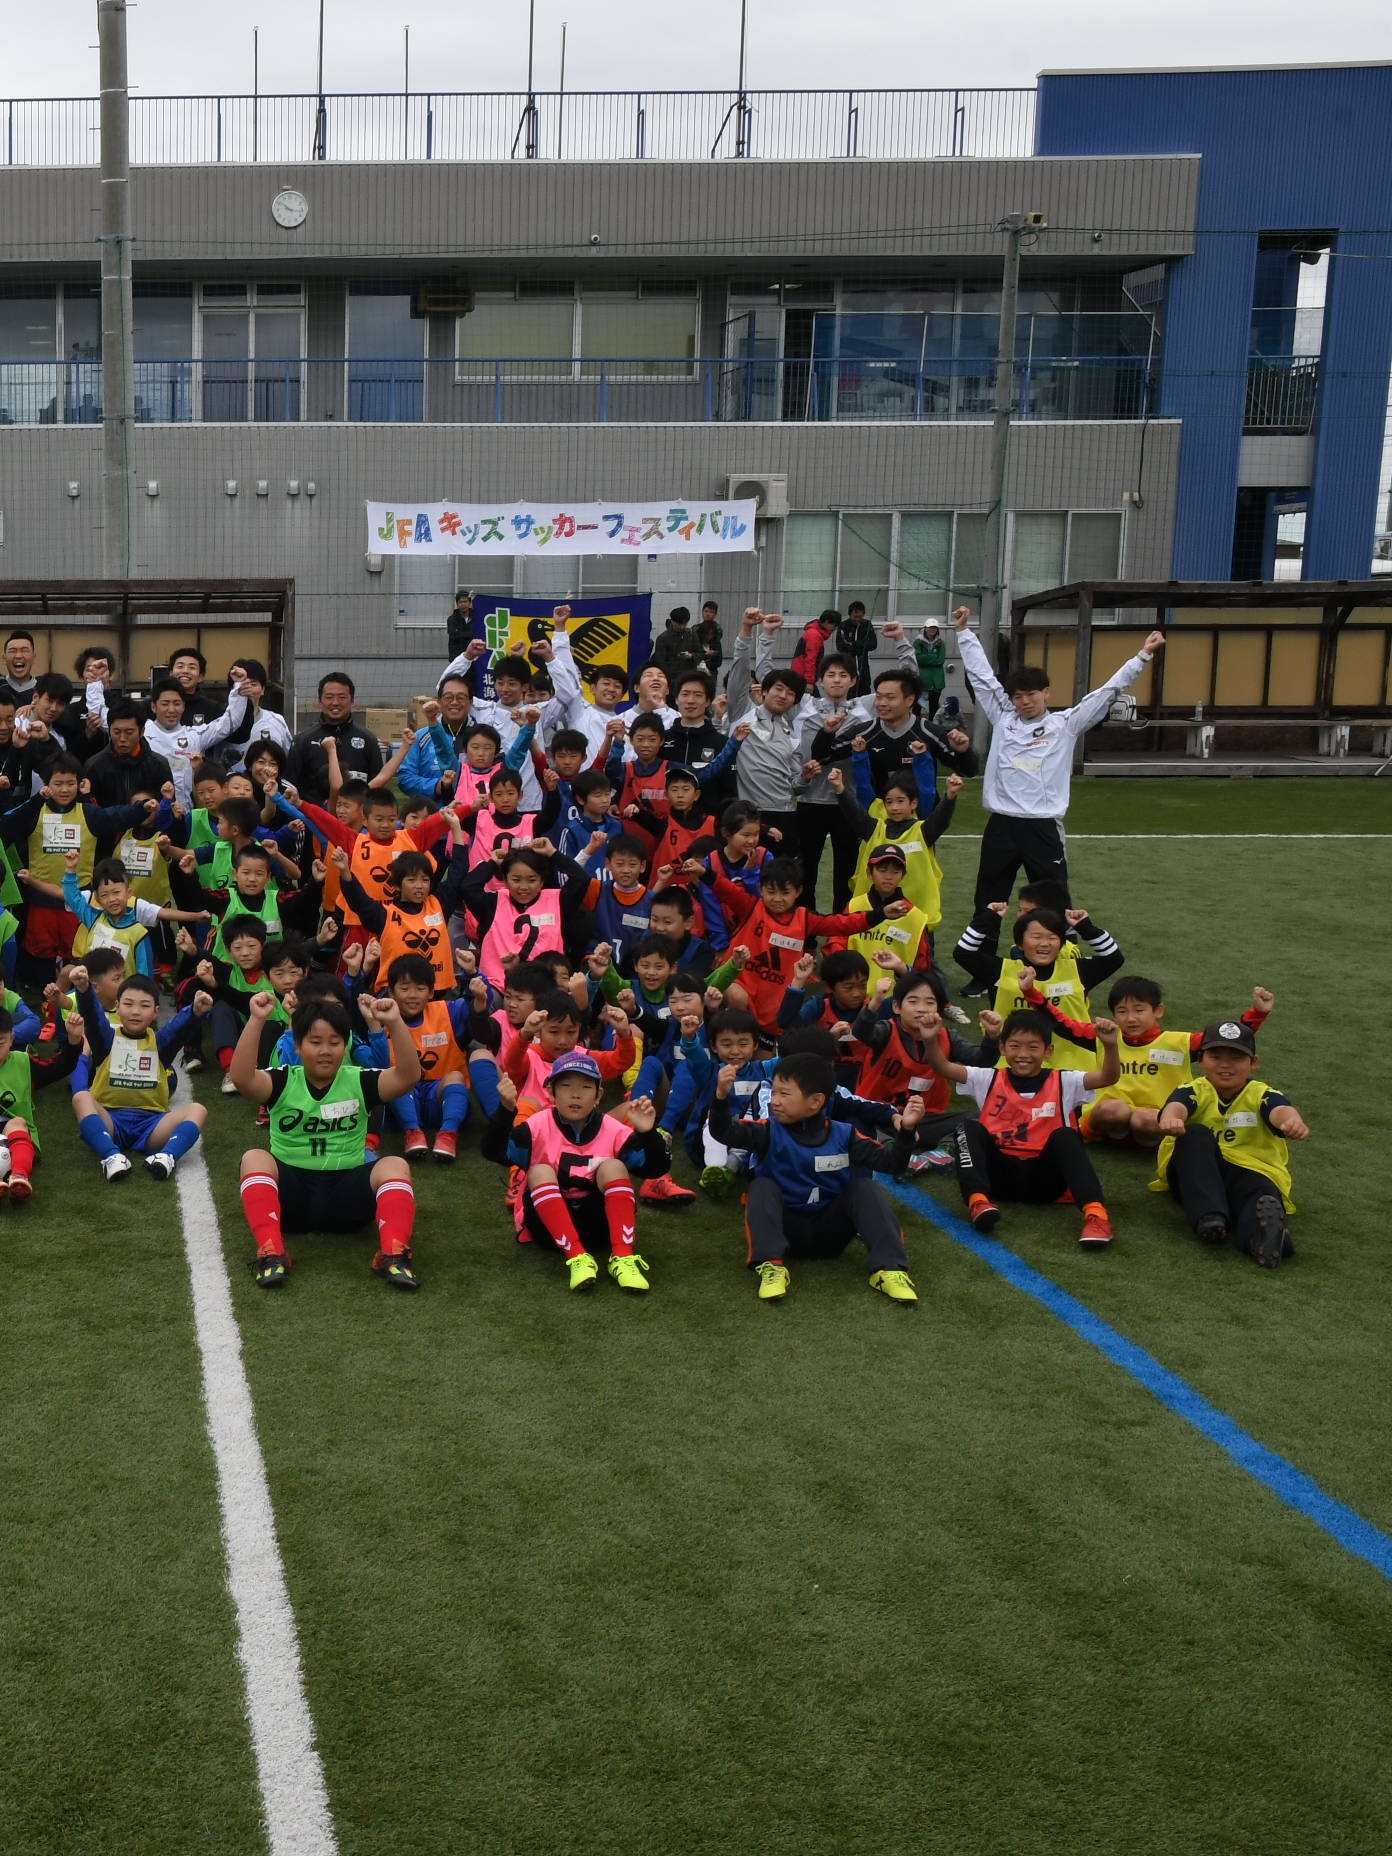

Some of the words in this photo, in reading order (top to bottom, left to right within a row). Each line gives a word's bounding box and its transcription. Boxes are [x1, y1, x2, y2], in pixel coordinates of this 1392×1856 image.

[378, 512, 432, 548] JFA
[669, 830, 678, 846] 6
[361, 841, 371, 860] 5
[392, 911, 402, 926] 4
[754, 920, 764, 937] 6
[859, 928, 893, 945] mitre
[613, 939, 622, 964] 7
[881, 1058, 902, 1079] 10
[989, 1095, 1007, 1117] 3
[303, 1113, 358, 1133] asics
[309, 1138, 325, 1157] 11
